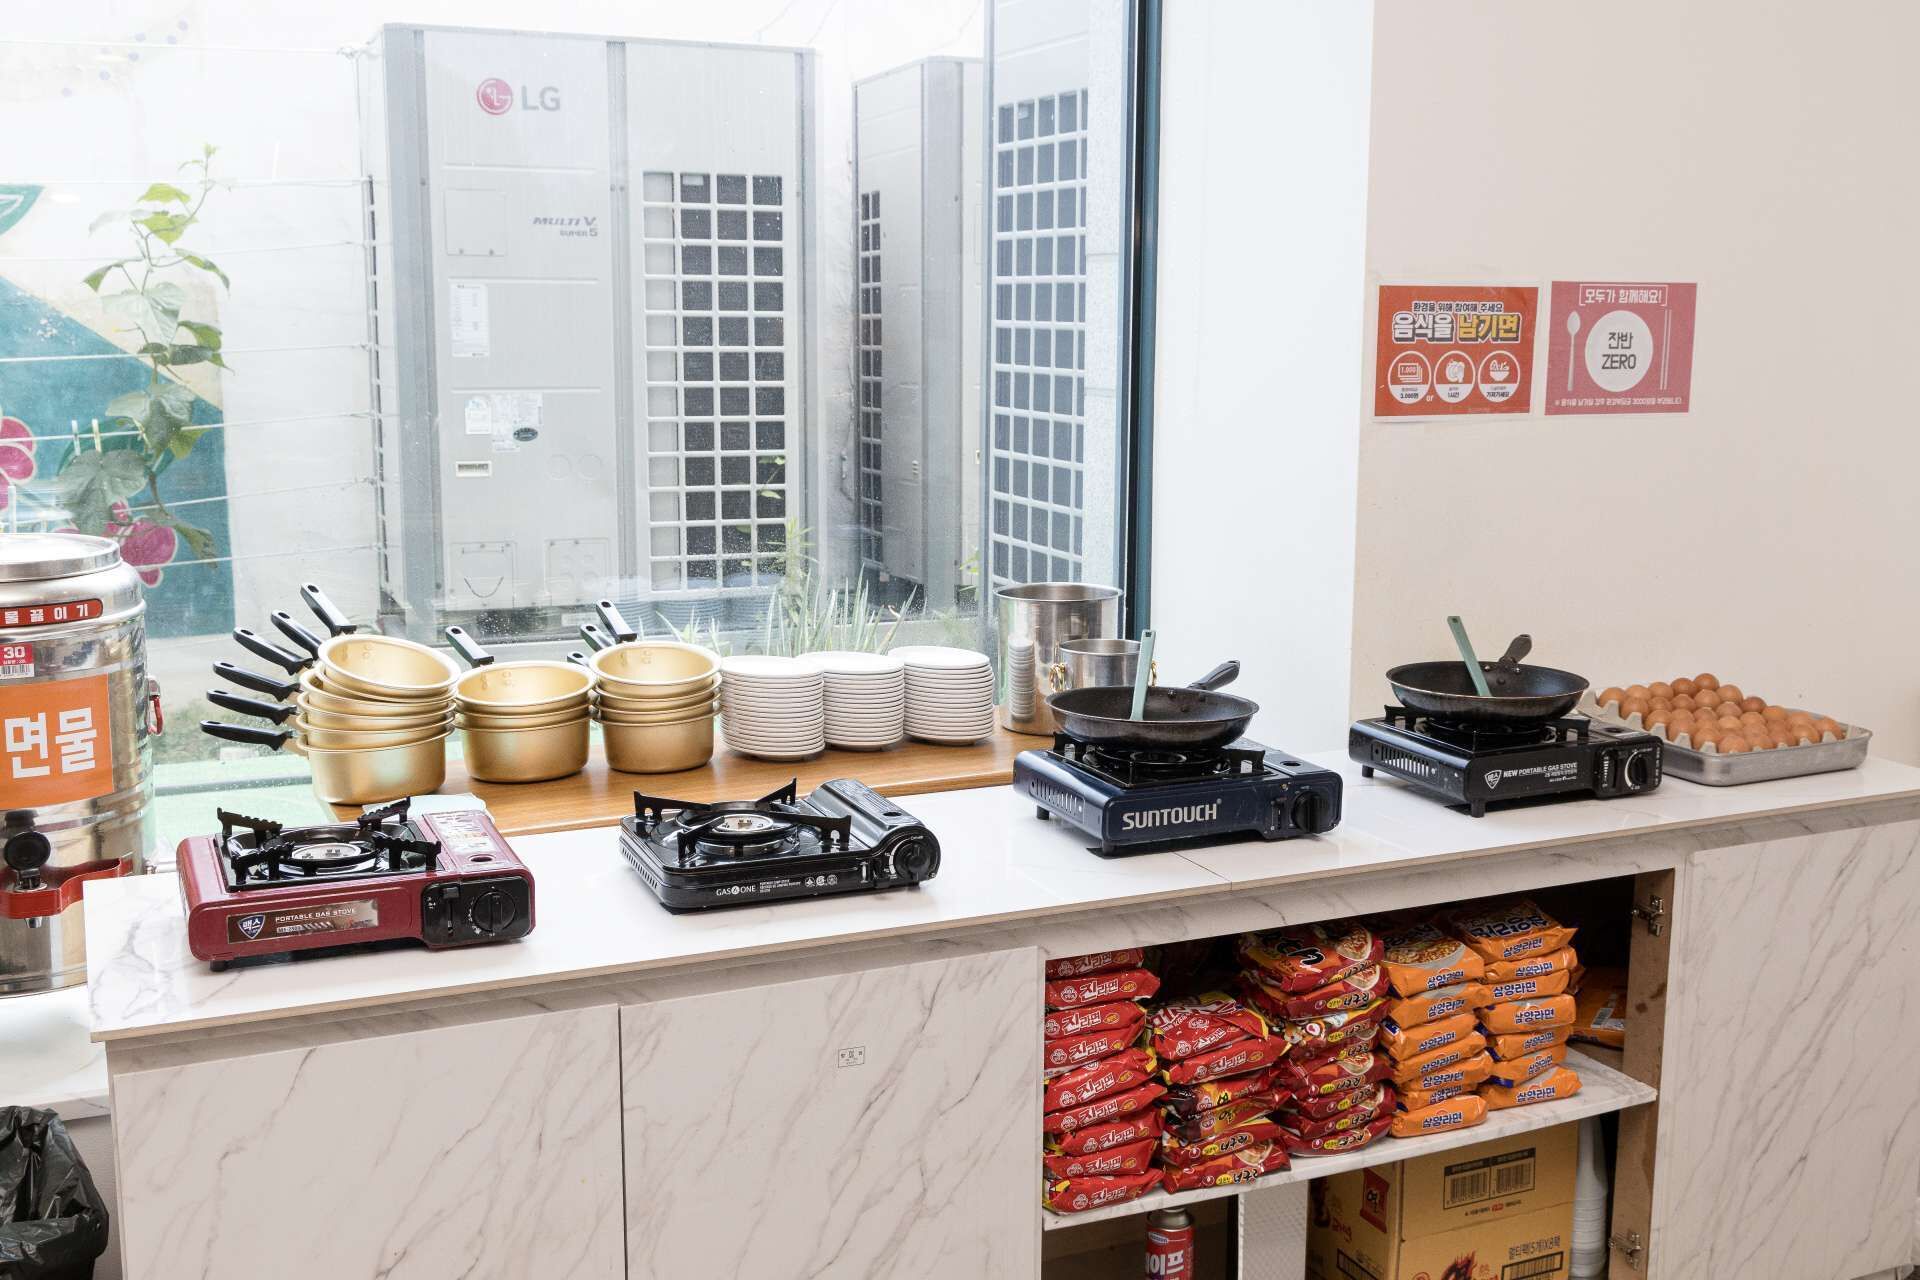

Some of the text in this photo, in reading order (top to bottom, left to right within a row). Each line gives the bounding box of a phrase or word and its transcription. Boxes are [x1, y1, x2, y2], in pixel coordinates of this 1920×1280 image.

[521, 86, 560, 112] LG
[532, 216, 581, 226] MULTI
[1585, 289, 1662, 305] 모두가 함께해요!
[1413, 302, 1437, 312] 환경을
[1438, 302, 1453, 312] 위해
[1480, 302, 1503, 313] 주세요
[1393, 312, 1520, 342] 음식을 남기면
[1608, 331, 1634, 350] 잔반
[1601, 353, 1637, 370] ZERO
[3, 646, 26, 659] 30
[1503, 769, 1518, 778] NEW
[1122, 801, 1218, 832] SUNTOUCH
[715, 888, 732, 896] GAS
[740, 885, 756, 894] ONE
[242, 917, 261, 931] 맥스
[275, 907, 356, 923] PORTABLE GAS STOVE
[1503, 938, 1543, 958] 삼양라면
[1515, 961, 1553, 978] 삼양라면
[1079, 978, 1119, 1003] 진라면
[1493, 980, 1537, 998] 삼양라면
[1427, 999, 1465, 1018] 삼양라면
[1514, 1007, 1555, 1025] 삼양라면
[1062, 1011, 1102, 1035] 진라면
[1069, 1037, 1108, 1063] 진라면
[1418, 1032, 1455, 1052] 삼양라면
[1209, 1051, 1247, 1073] 진라면
[1420, 1054, 1460, 1073] 삼양라면
[1076, 1072, 1116, 1101] 진라면
[1422, 1071, 1464, 1088] 삼양라면
[1516, 1086, 1555, 1104] 삼양라면
[1079, 1099, 1119, 1127] 진라면
[1422, 1110, 1463, 1129] 삼양라면
[1098, 1127, 1135, 1150] 진라면
[1220, 1135, 1248, 1151] 너구리
[1085, 1155, 1122, 1176] 진라면
